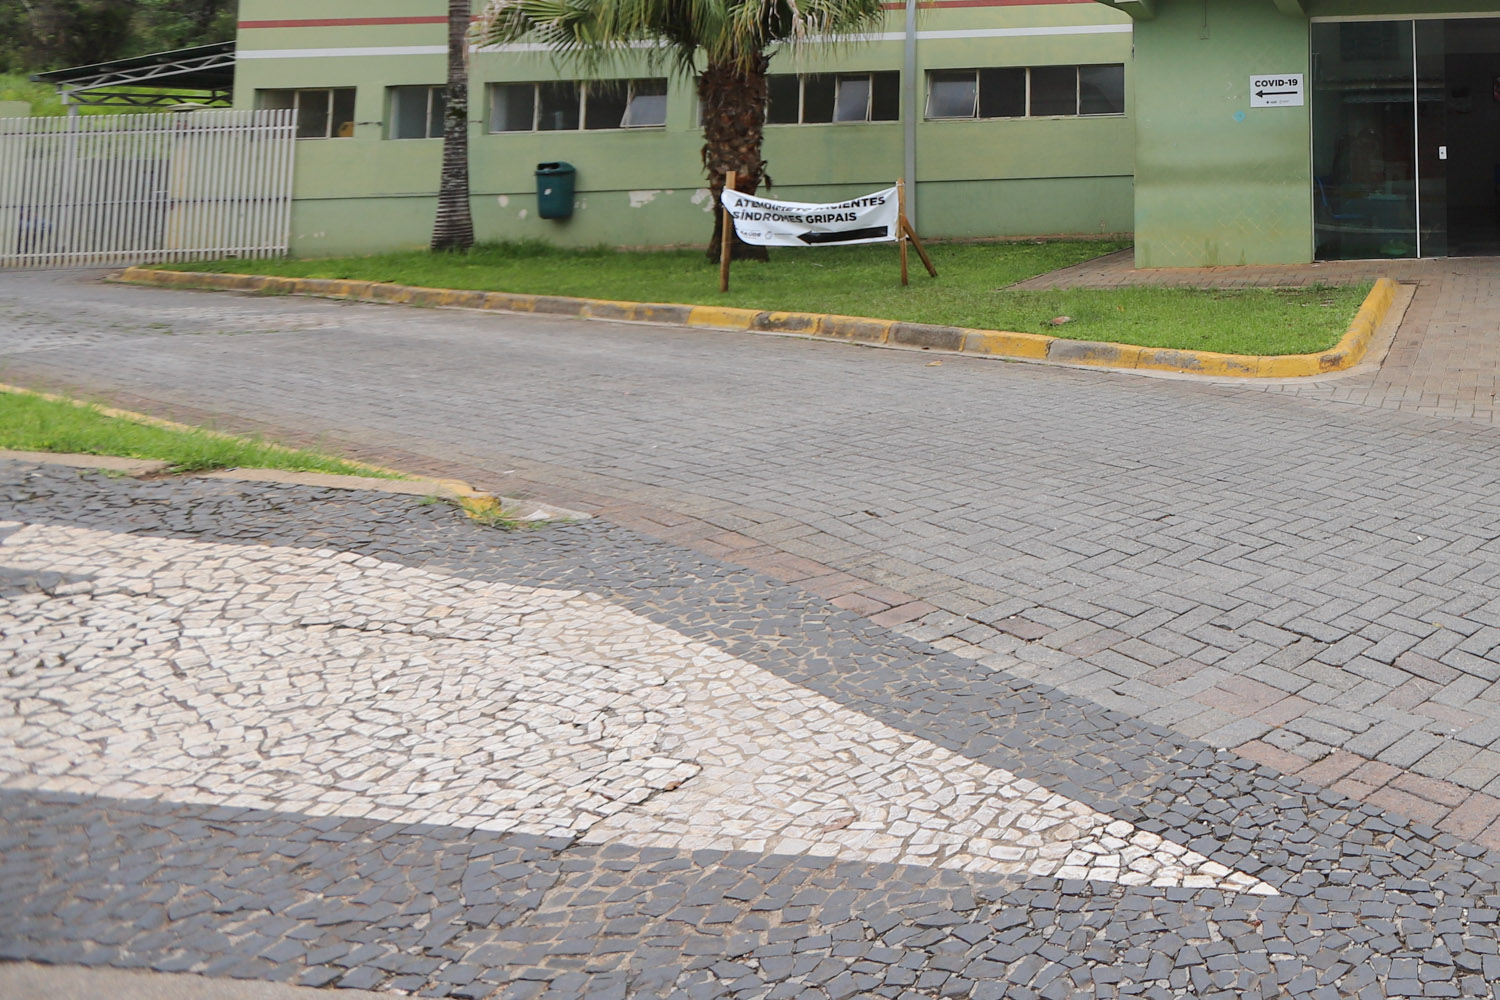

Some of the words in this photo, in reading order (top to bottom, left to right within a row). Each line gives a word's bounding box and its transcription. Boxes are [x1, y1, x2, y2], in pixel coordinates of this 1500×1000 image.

[1255, 79, 1298, 87] COVID-19
[733, 209, 803, 224] SÍNDROMES
[805, 212, 857, 224] GRIPAIS
